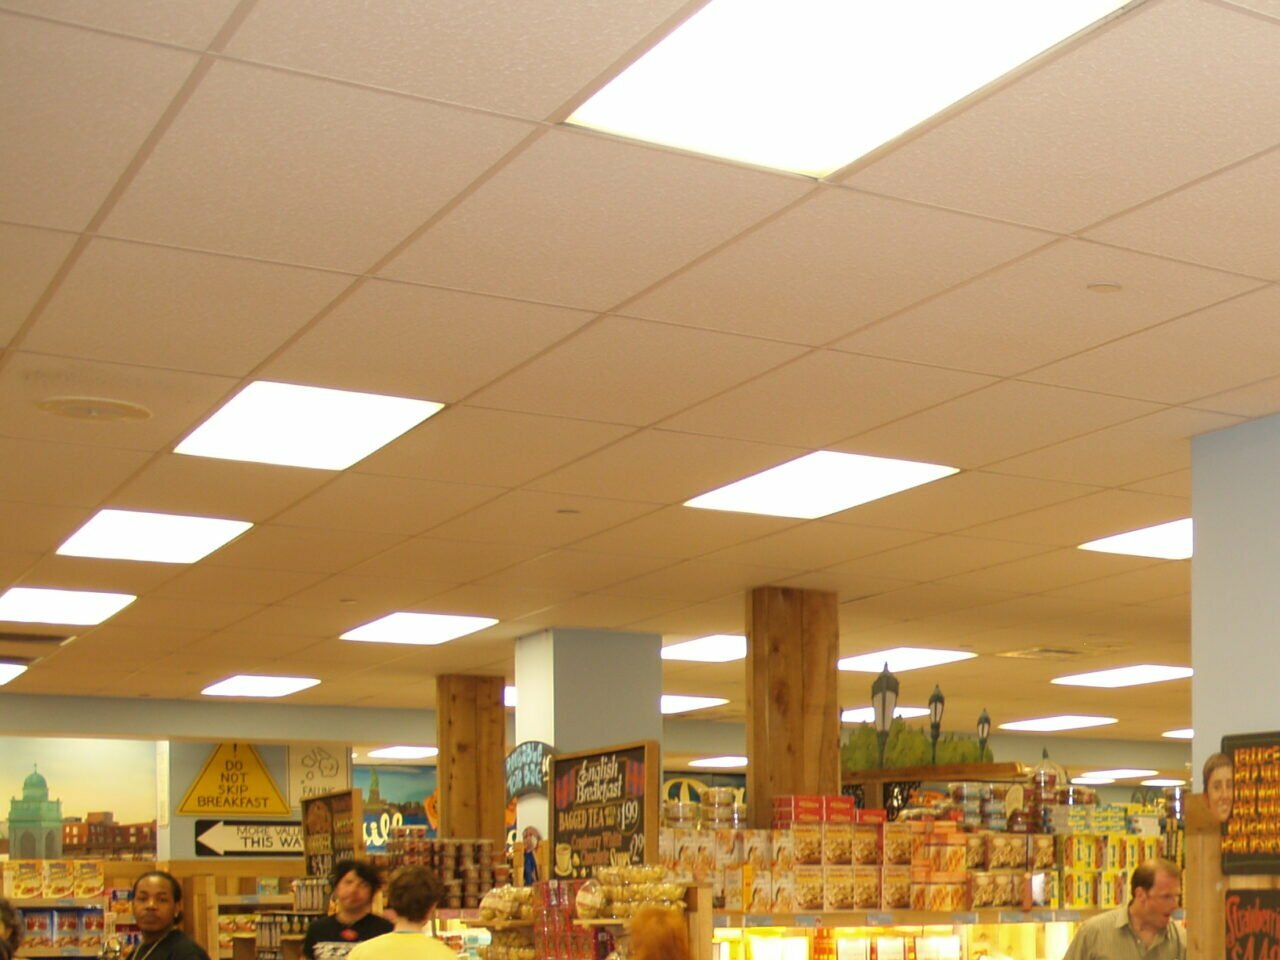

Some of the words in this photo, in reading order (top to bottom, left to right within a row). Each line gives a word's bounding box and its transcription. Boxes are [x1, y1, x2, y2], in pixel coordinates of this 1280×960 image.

[226, 760, 243, 771] DO
[578, 753, 619, 786] English
[221, 772, 248, 784] NOT
[218, 784, 249, 796] SKIP
[576, 774, 622, 803] Breakfast
[197, 796, 269, 808] BREAKFAST
[558, 809, 587, 833] BAGGED
[588, 807, 604, 829] TEA
[236, 826, 269, 836] MORE
[274, 826, 302, 836] VALU
[240, 837, 273, 849] THIS
[280, 837, 303, 848] WA
